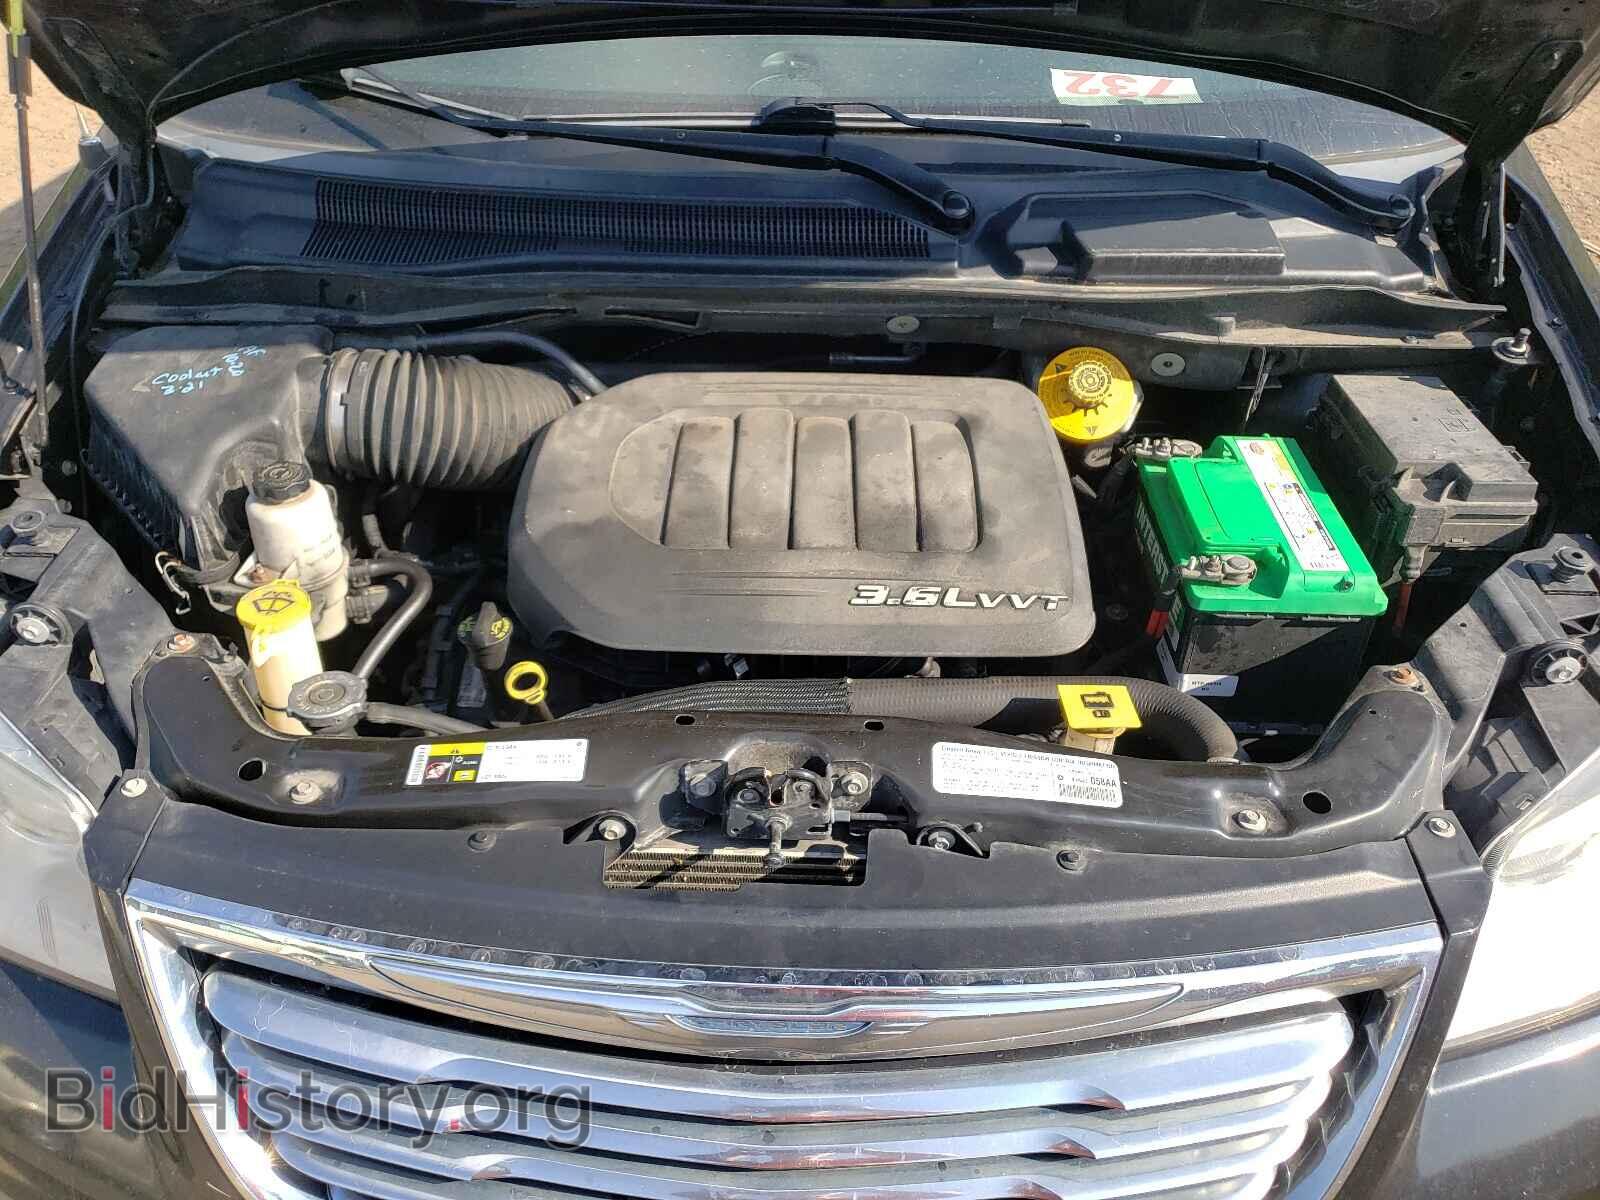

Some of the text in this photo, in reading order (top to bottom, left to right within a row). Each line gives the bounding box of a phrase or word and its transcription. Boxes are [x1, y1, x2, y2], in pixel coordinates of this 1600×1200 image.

[1064, 72, 1180, 98] 732
[848, 584, 1069, 611] 3.6L VVT
